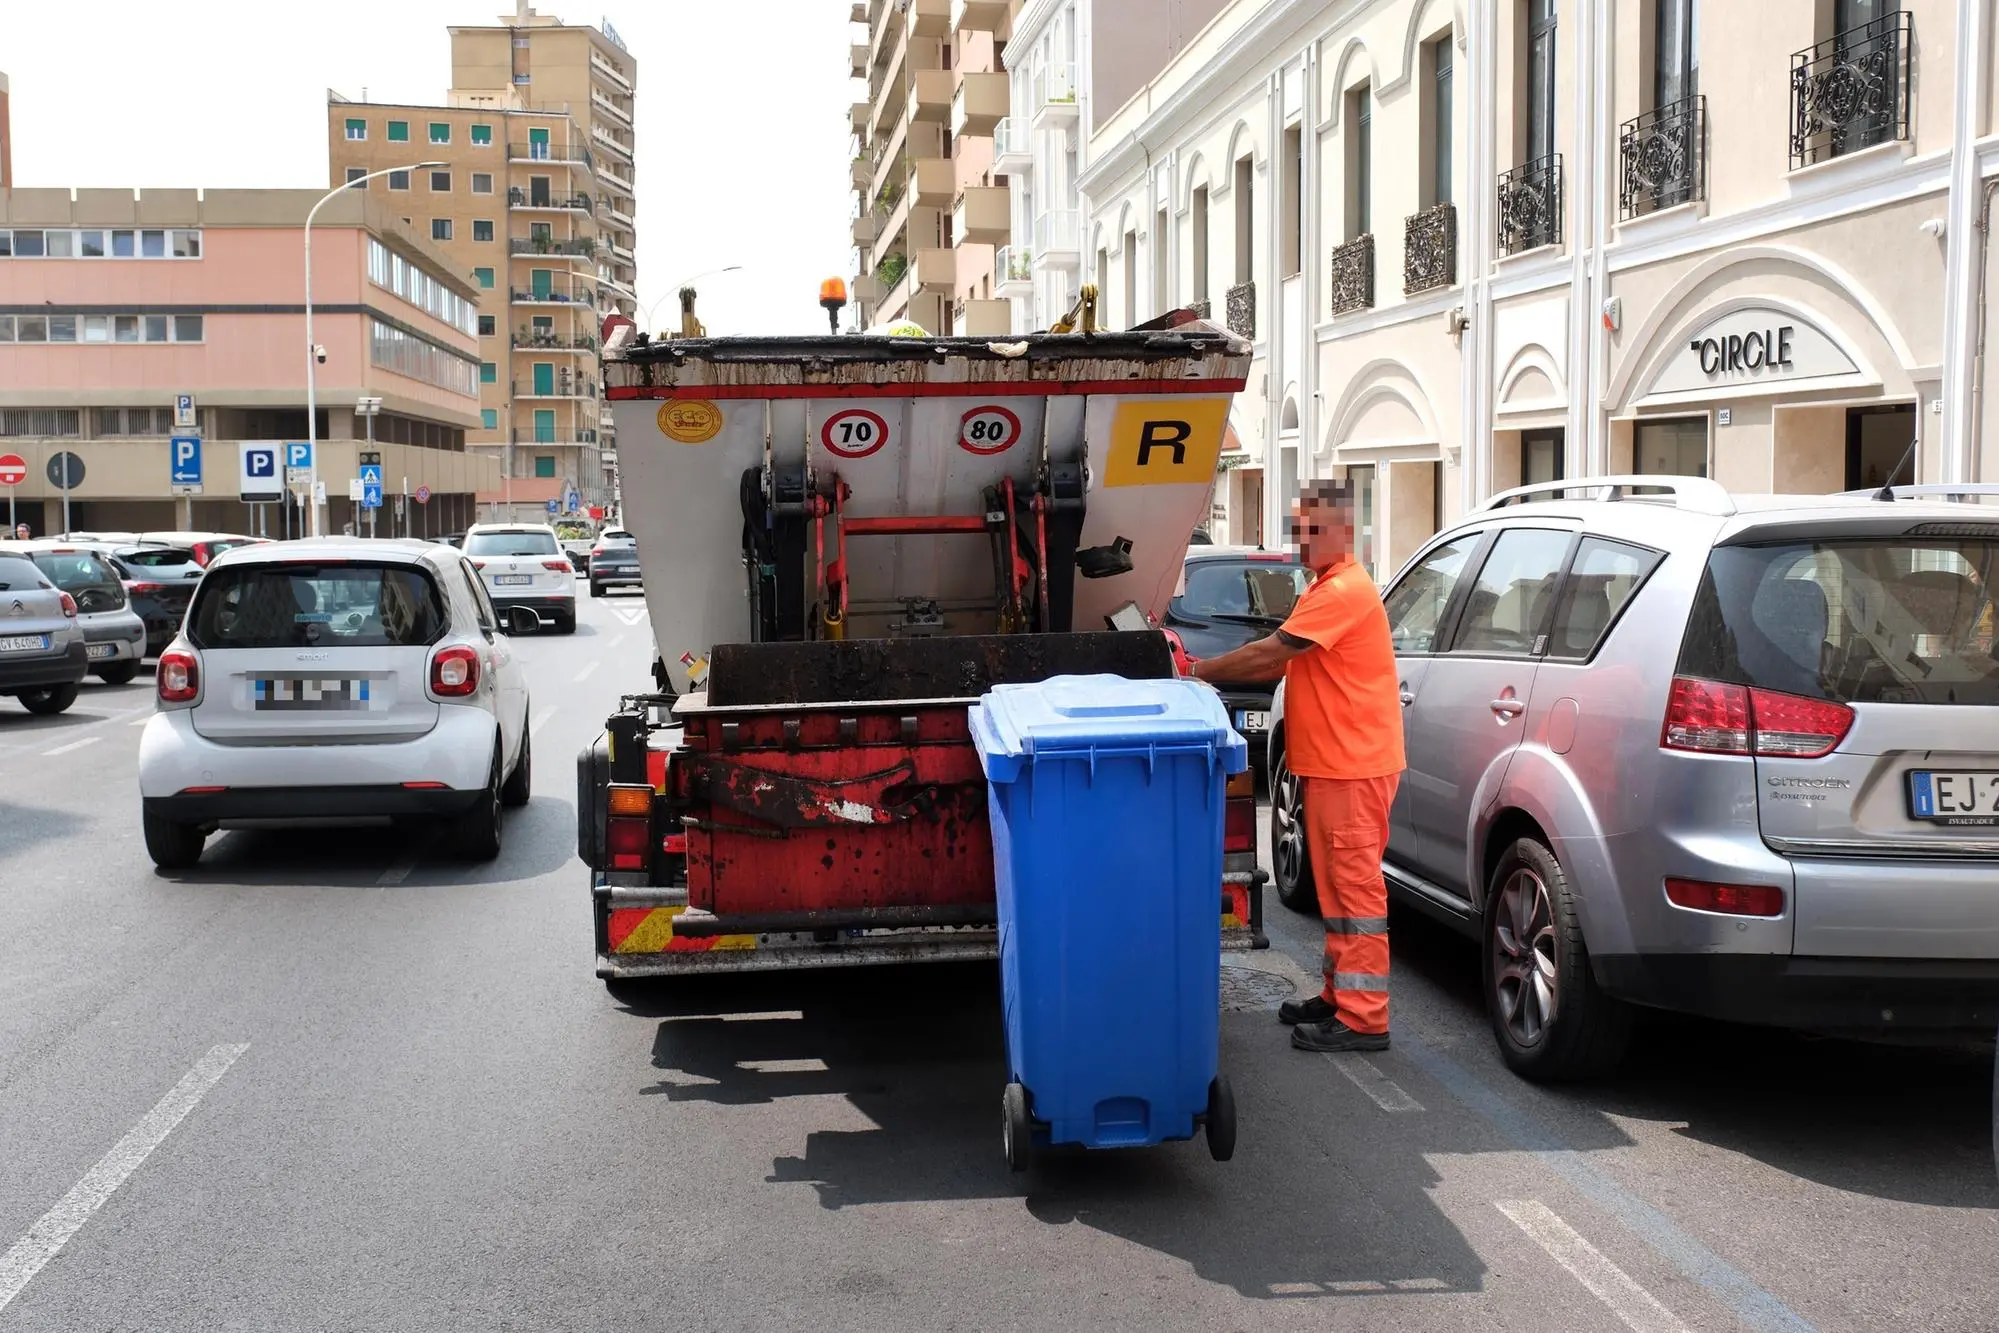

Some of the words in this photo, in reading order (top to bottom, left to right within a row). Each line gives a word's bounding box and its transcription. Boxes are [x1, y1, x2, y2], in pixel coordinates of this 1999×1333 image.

[1700, 326, 1793, 374] CIRCLE
[180, 397, 189, 408] P
[840, 422, 872, 442] 70
[970, 420, 1003, 441] 80
[1137, 421, 1191, 465] R
[177, 441, 194, 467] P
[252, 453, 269, 474] P
[291, 445, 307, 465] P
[1246, 712, 1264, 728] EJ
[1937, 777, 1976, 812] EJ
